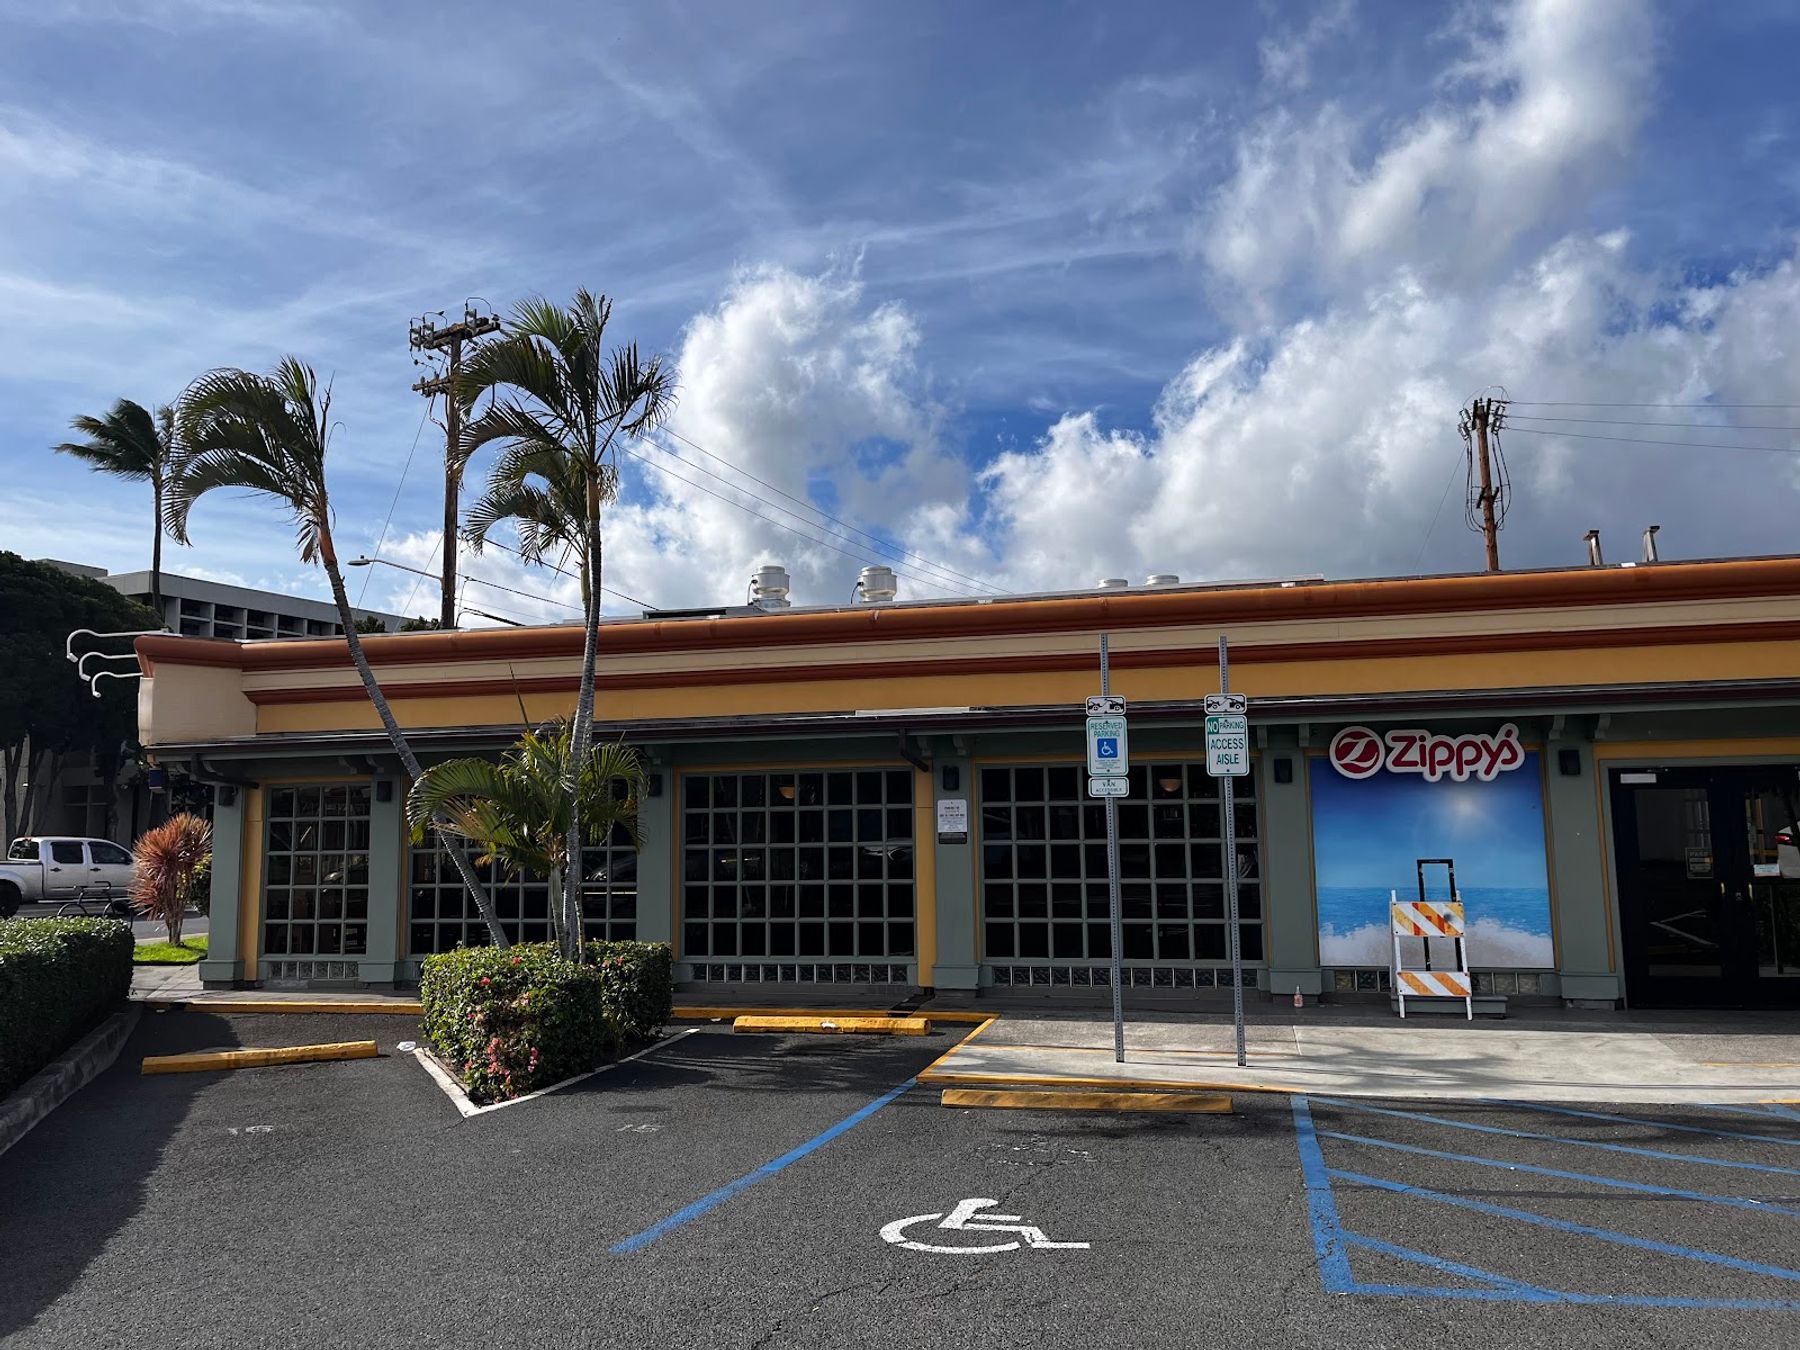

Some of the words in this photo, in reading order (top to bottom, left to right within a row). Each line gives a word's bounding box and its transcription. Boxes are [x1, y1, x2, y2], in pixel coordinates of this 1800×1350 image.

[1090, 722, 1122, 730] RESERVED
[1208, 721, 1219, 733] NO
[1220, 721, 1245, 730] PARKING
[1210, 738, 1244, 750] ACCESS
[1390, 728, 1519, 777] Zippy's
[1216, 753, 1240, 765] AISLE
